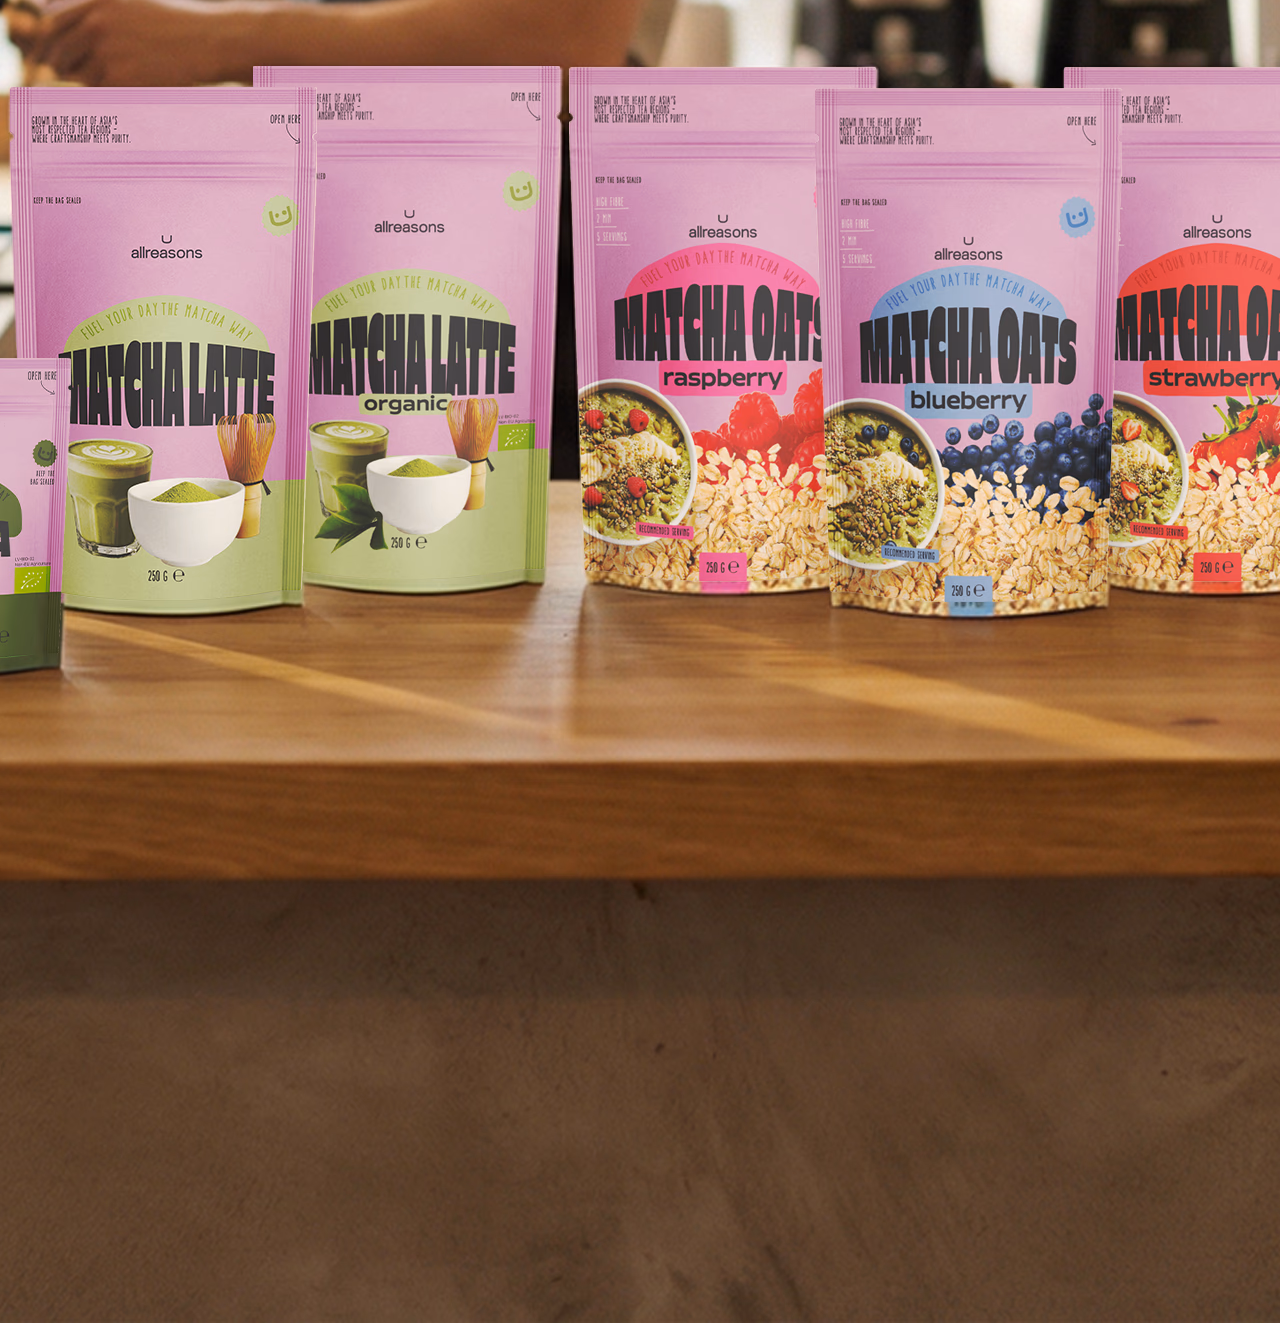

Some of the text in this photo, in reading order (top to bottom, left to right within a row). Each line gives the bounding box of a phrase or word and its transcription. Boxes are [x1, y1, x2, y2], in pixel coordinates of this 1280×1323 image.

[510, 92, 541, 102] OPEN HERE
[1067, 116, 1096, 126] OPEN HERE
[374, 220, 445, 233] allreasons
[688, 226, 758, 238] allreasons
[1183, 226, 1252, 238] allreasons
[131, 246, 203, 259] allreasons
[934, 247, 1003, 261] allreasons
[885, 289, 909, 311] FUEL
[910, 277, 937, 297] YOUR
[985, 274, 1023, 298] MATCHA
[1028, 290, 1052, 312] WAY
[614, 283, 746, 362] MATCHA
[1115, 284, 1241, 362] MATCHA
[859, 306, 1077, 385] MATCHA OATS
[310, 312, 516, 396] MATCHA LATTE
[28, 371, 57, 380] OPEN HERE
[663, 368, 783, 391] raspberry
[59, 340, 275, 429] MATCHA LATTE
[364, 395, 448, 415] organic
[911, 390, 1027, 413] blueberry
[639, 524, 690, 537] RECOMMENDED SERVING
[391, 536, 410, 548] 250 G
[706, 562, 726, 574] 250 G
[1200, 562, 1220, 574] 250 G
[148, 570, 168, 582] 250 G
[952, 585, 970, 596] 250 G
